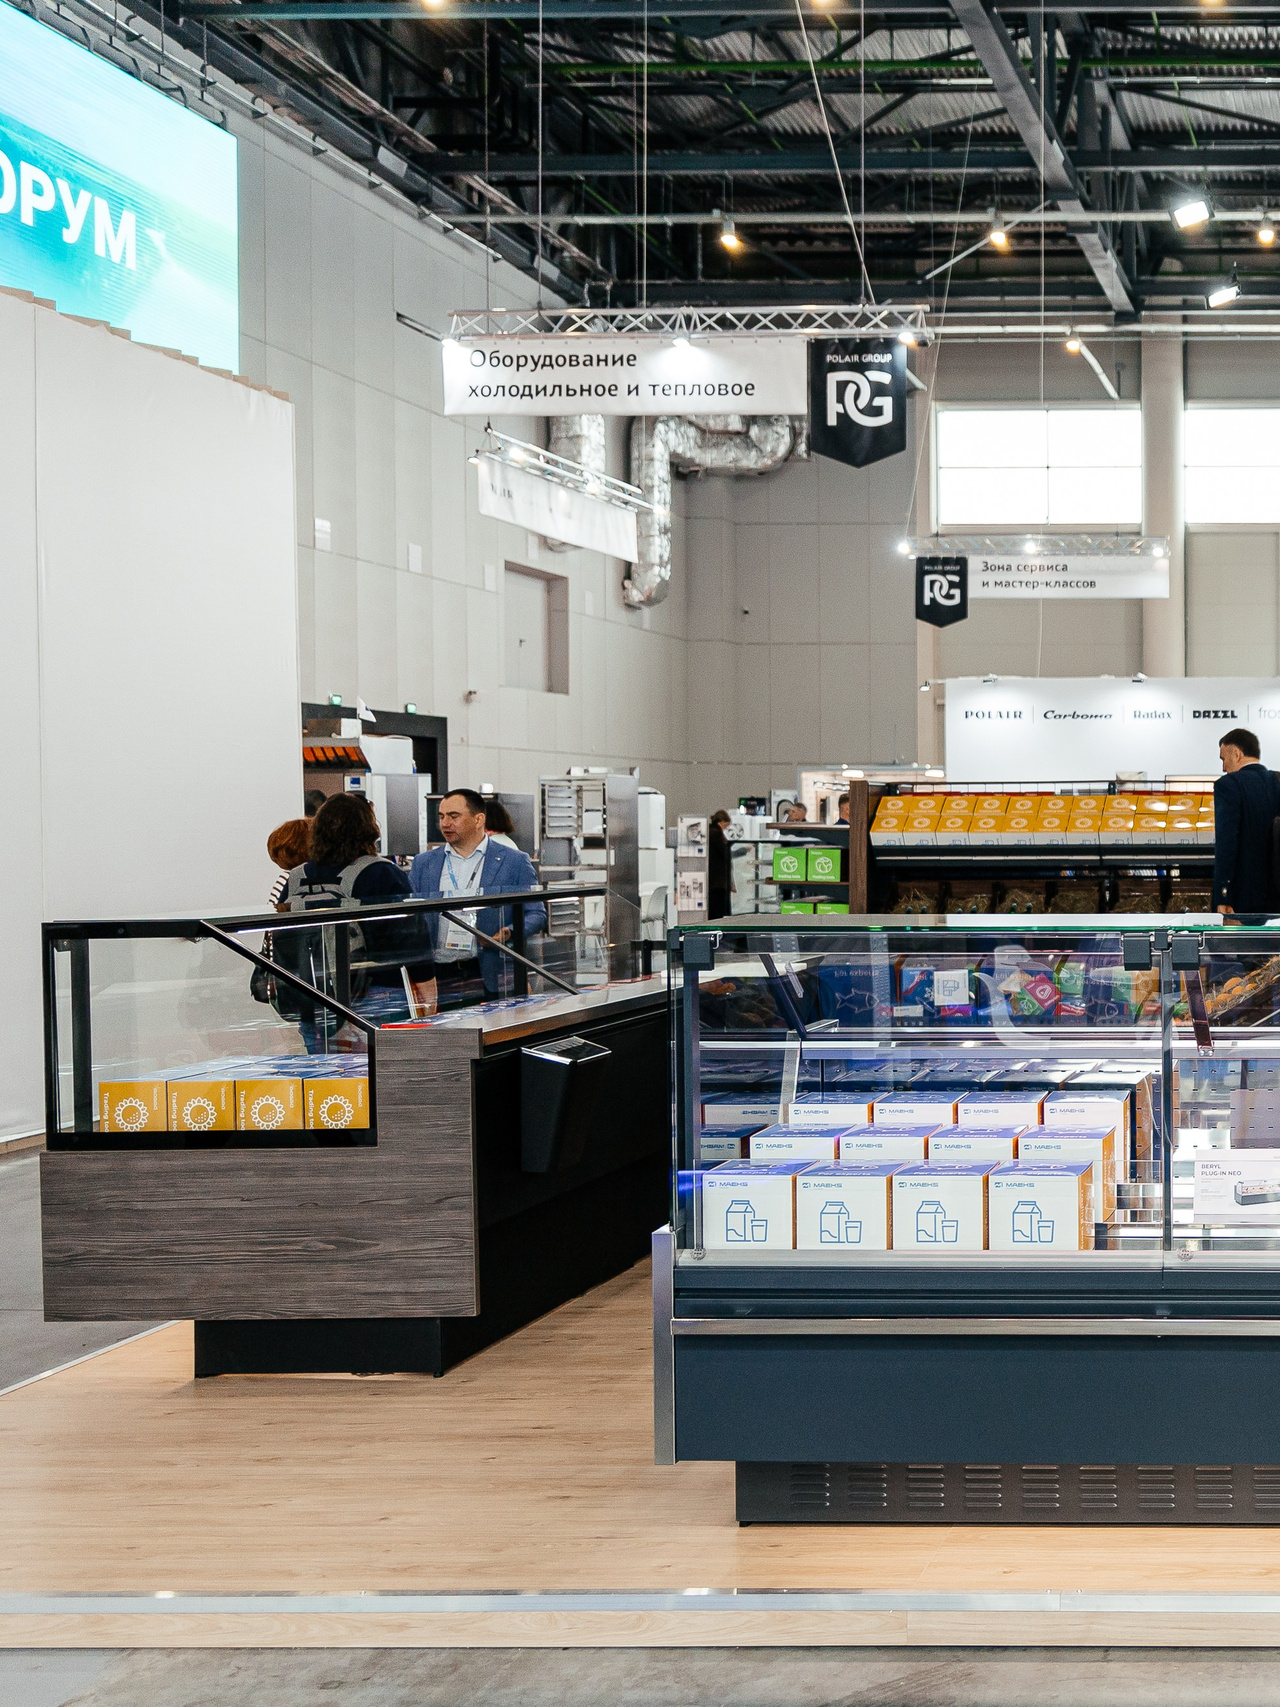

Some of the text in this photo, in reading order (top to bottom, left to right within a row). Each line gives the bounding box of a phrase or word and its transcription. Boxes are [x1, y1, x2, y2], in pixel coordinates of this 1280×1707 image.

[470, 349, 637, 372] Оборудование
[826, 353, 893, 363] POLAIR GROUP
[468, 383, 756, 400] холодильное и тепловое
[982, 561, 1068, 575] Зона сервиса
[982, 579, 1097, 591] и мастер-классов
[964, 710, 1023, 720] POLAIR
[1043, 709, 1113, 720] Carboma
[1133, 710, 1172, 719] Radax
[1192, 710, 1238, 719] DAZZL
